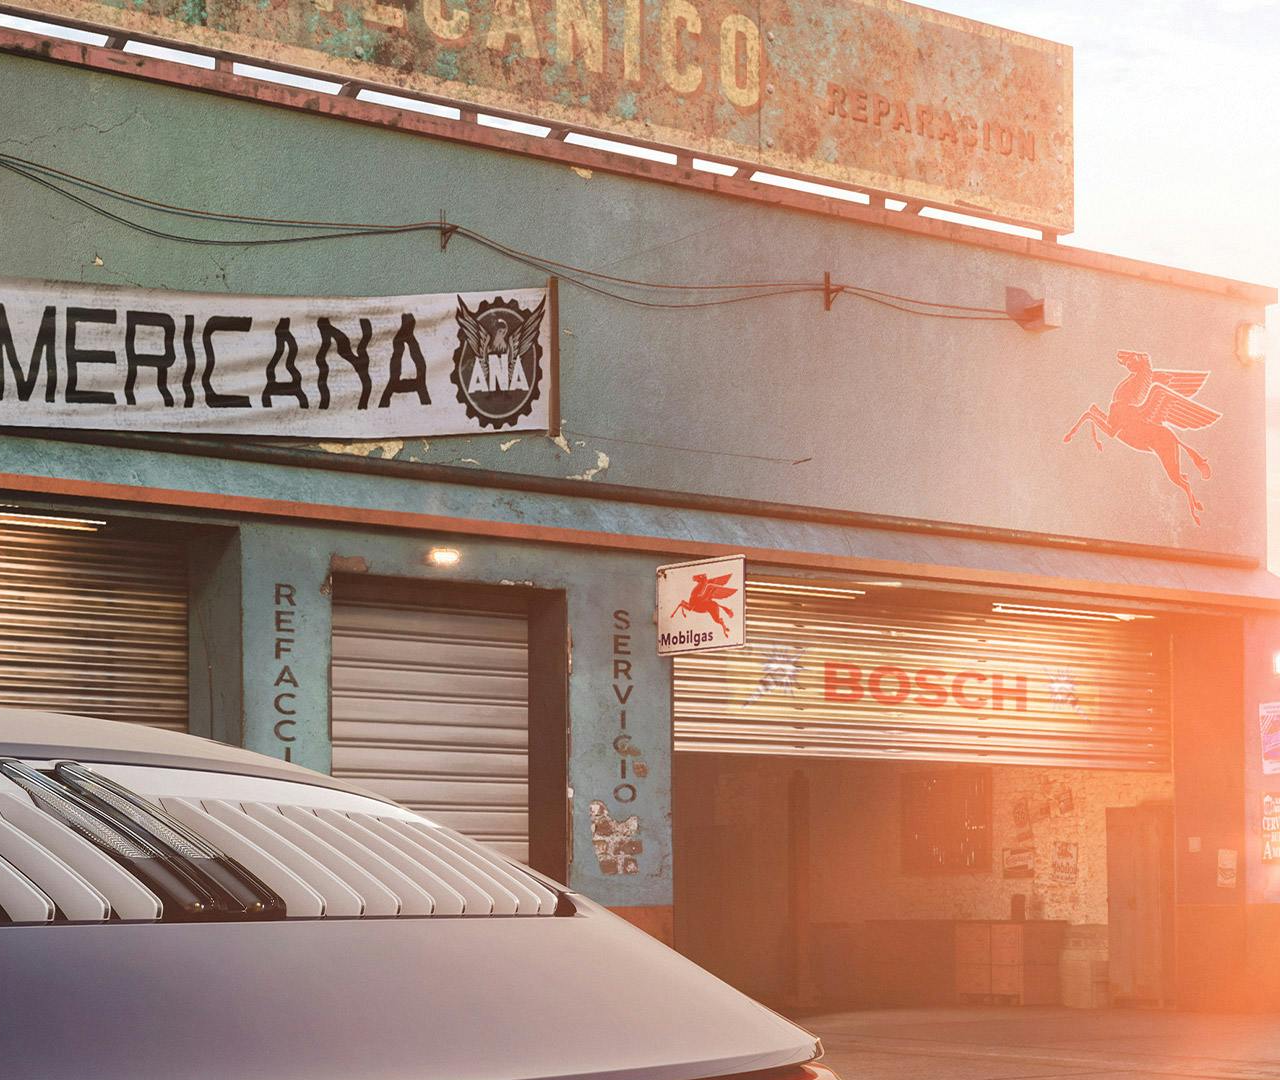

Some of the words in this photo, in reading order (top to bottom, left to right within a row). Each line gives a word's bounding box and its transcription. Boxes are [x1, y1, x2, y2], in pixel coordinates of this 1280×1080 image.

[468, 353, 530, 394] ANA
[660, 629, 714, 647] Mobilgas
[612, 610, 636, 803] SERVICIO
[823, 661, 1027, 711] BOSCH
